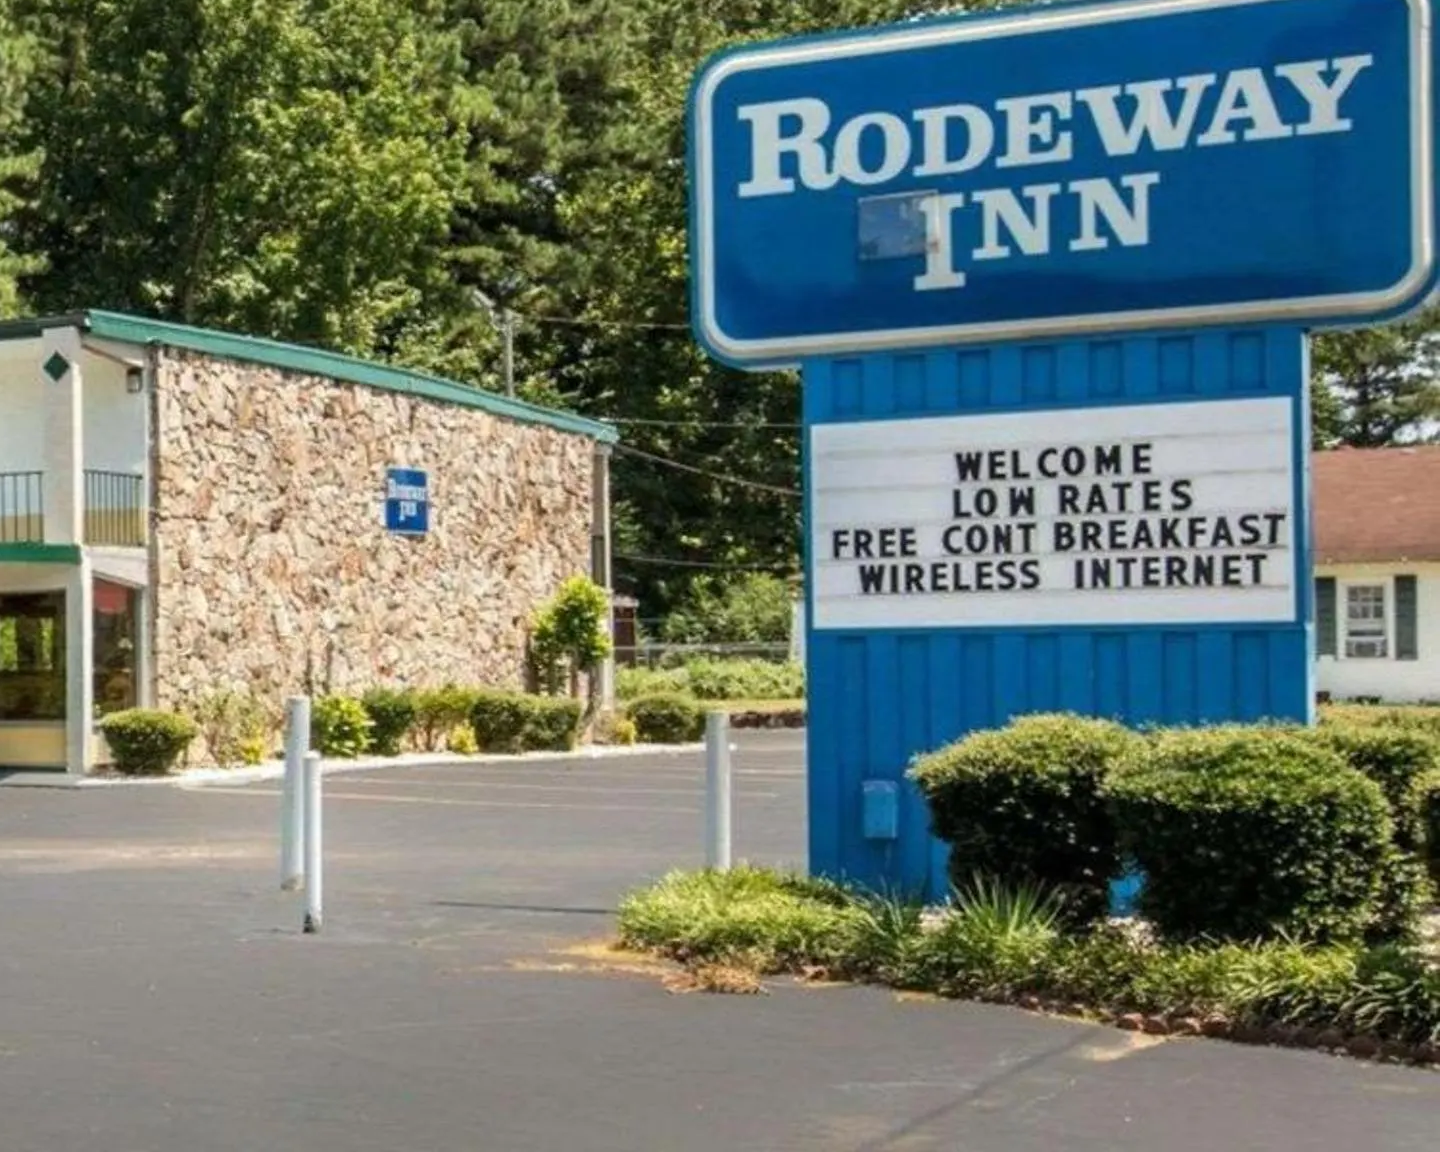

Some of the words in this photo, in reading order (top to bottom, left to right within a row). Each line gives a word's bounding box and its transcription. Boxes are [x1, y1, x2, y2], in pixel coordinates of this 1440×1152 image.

[738, 54, 1372, 197] RODEWAY
[914, 173, 1159, 290] INN
[955, 442, 1152, 482] WELCOME
[953, 486, 1036, 519] LOW
[1058, 479, 1193, 515] RATES
[832, 527, 918, 561] FREE
[942, 522, 1037, 556] CONT
[1053, 513, 1287, 553] BREAKFAST
[858, 559, 1040, 595] WIRELESS
[1075, 553, 1268, 590] INTERNET
